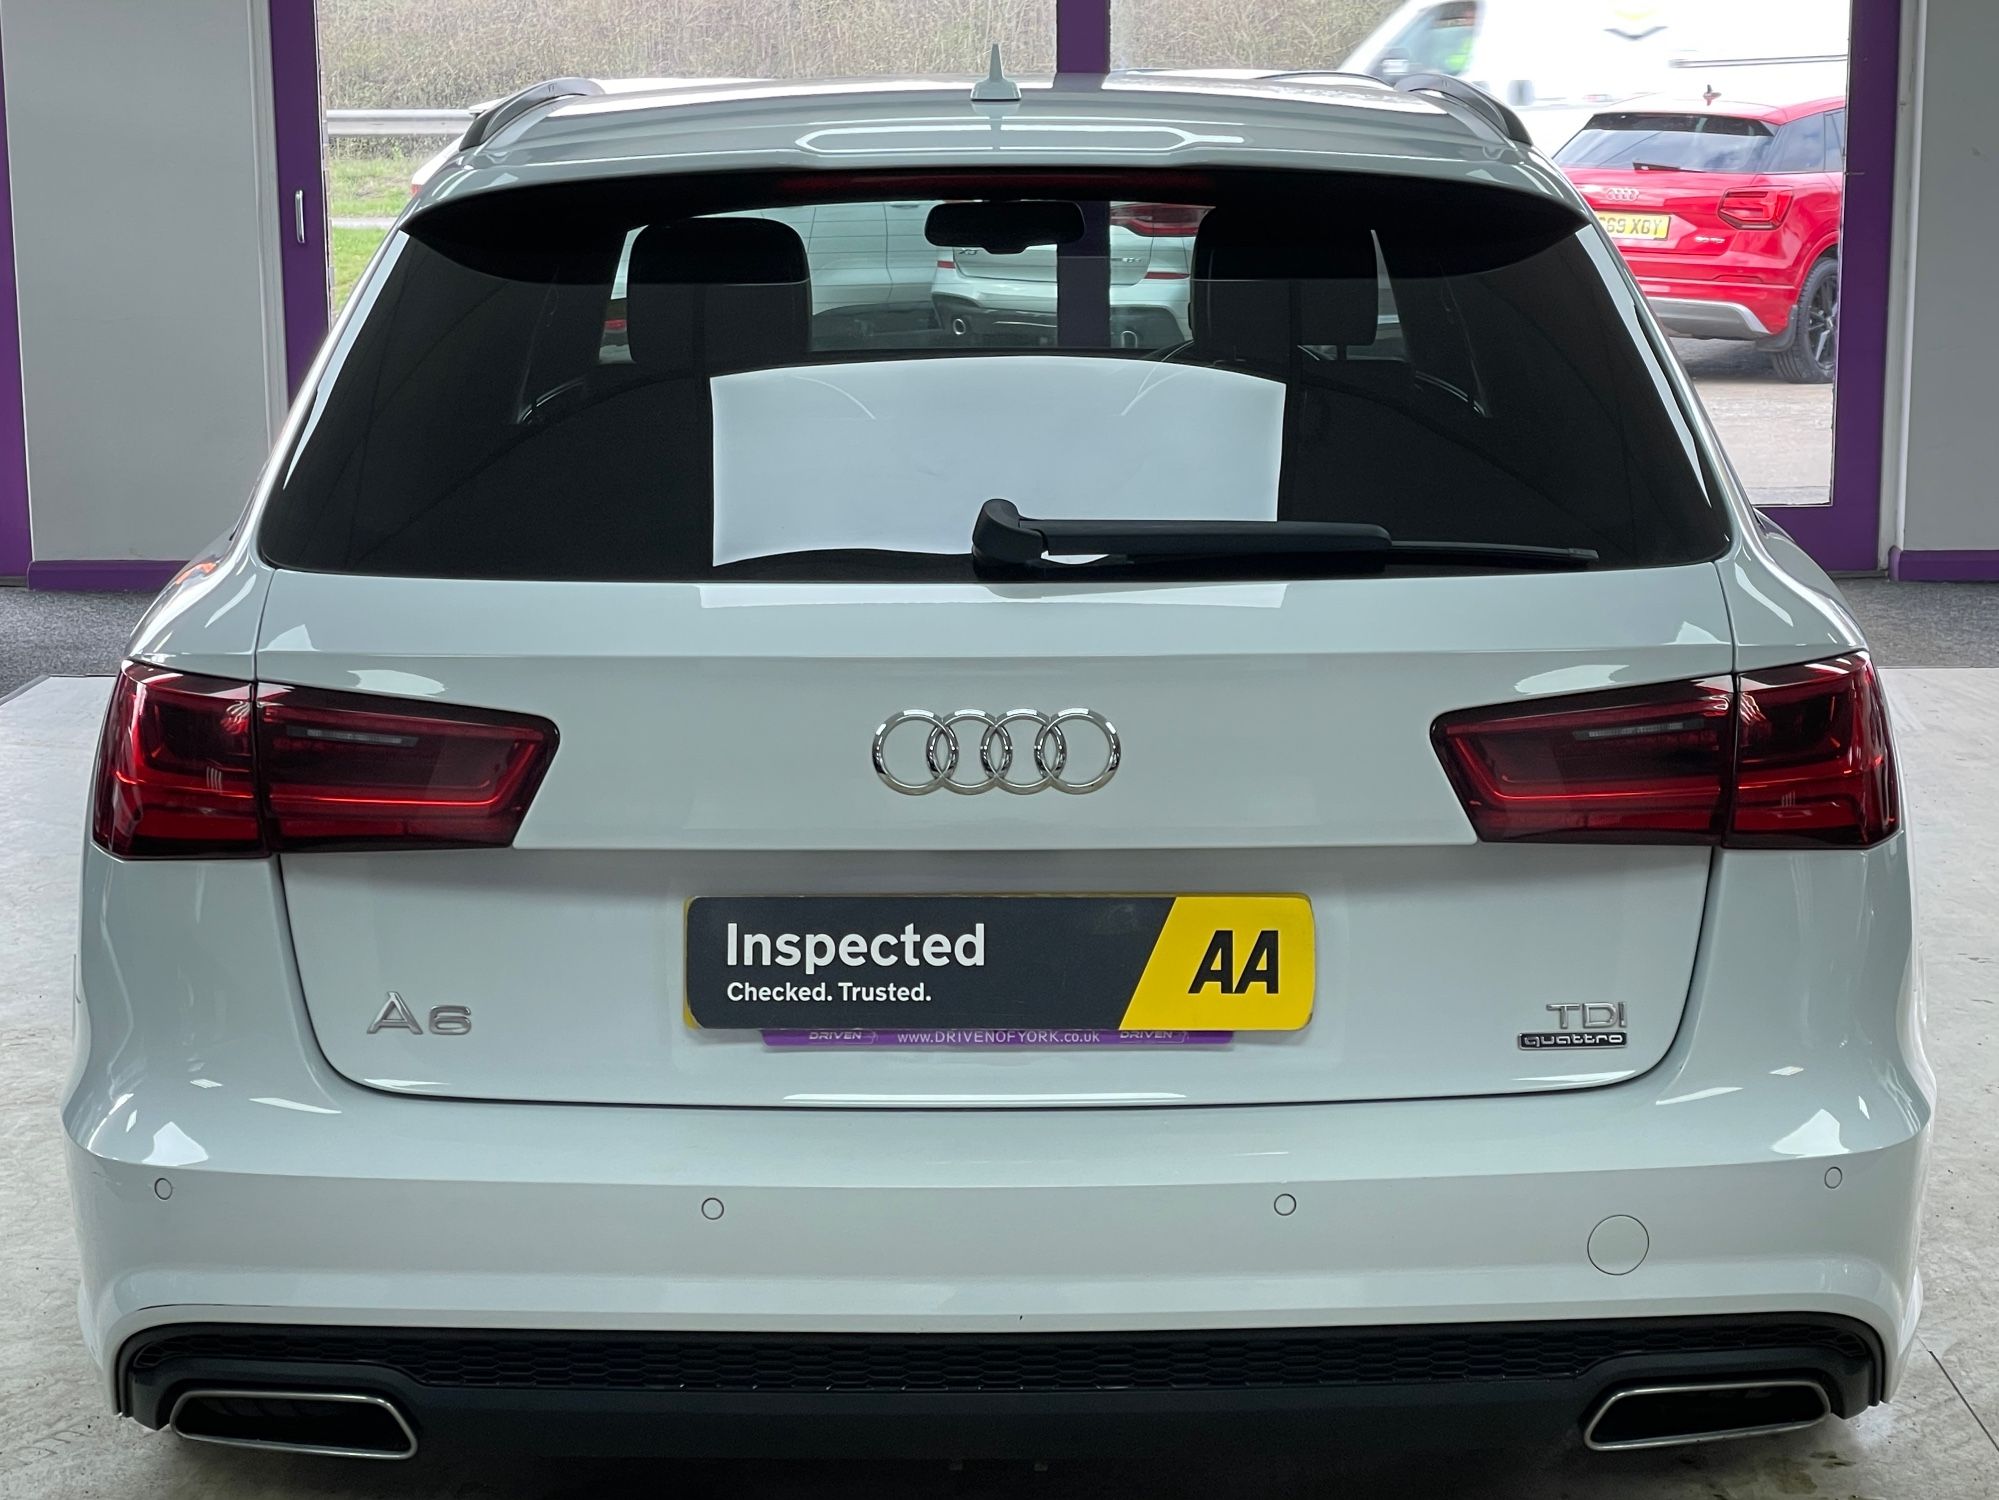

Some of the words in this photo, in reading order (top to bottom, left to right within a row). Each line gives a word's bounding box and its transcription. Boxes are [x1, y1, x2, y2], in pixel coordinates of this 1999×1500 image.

[727, 923, 985, 975] Inspected
[1188, 930, 1279, 994] AA
[727, 982, 833, 1002] Checked.
[838, 982, 932, 1002] Trusted.
[367, 991, 472, 1036] A6
[1546, 1002, 1627, 1029] TDI
[808, 1031, 862, 1040] DRIVEN
[897, 1030, 1100, 1044] www.DRIVENOFYORK.co.uk
[1120, 1030, 1173, 1039] DRIVEN
[1523, 1033, 1624, 1047] quattro
